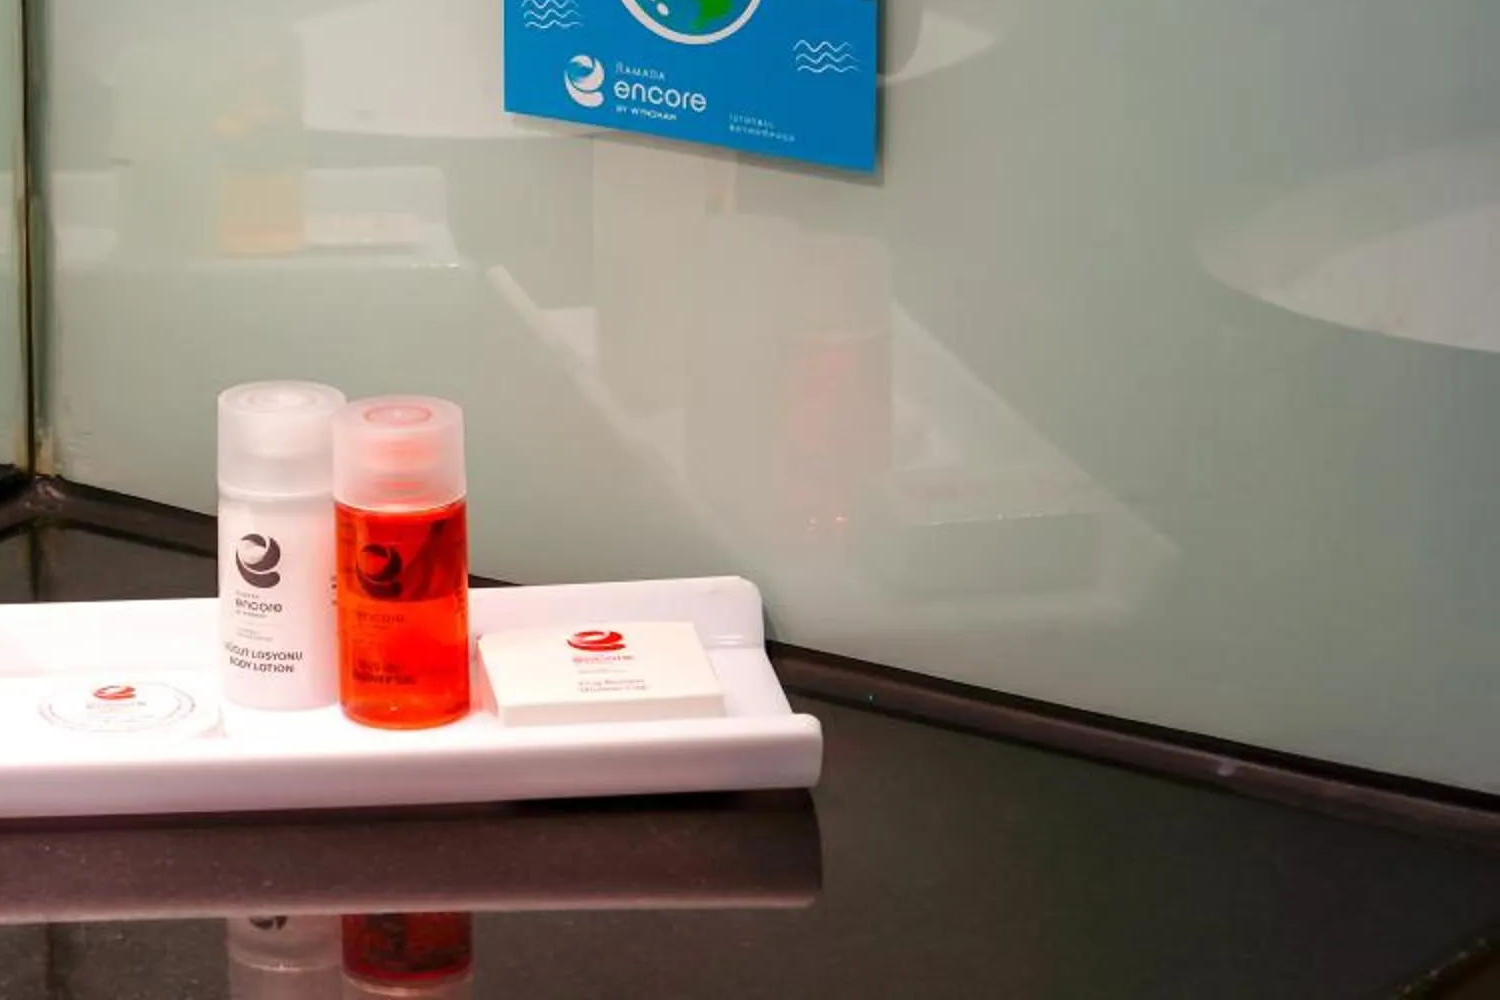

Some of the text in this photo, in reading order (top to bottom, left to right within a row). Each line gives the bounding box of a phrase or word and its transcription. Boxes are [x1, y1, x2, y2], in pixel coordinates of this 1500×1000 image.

[615, 62, 665, 81] RAMADA
[613, 80, 707, 112] encore
[251, 649, 303, 662] LOSYONU
[253, 662, 294, 673] LOTION
